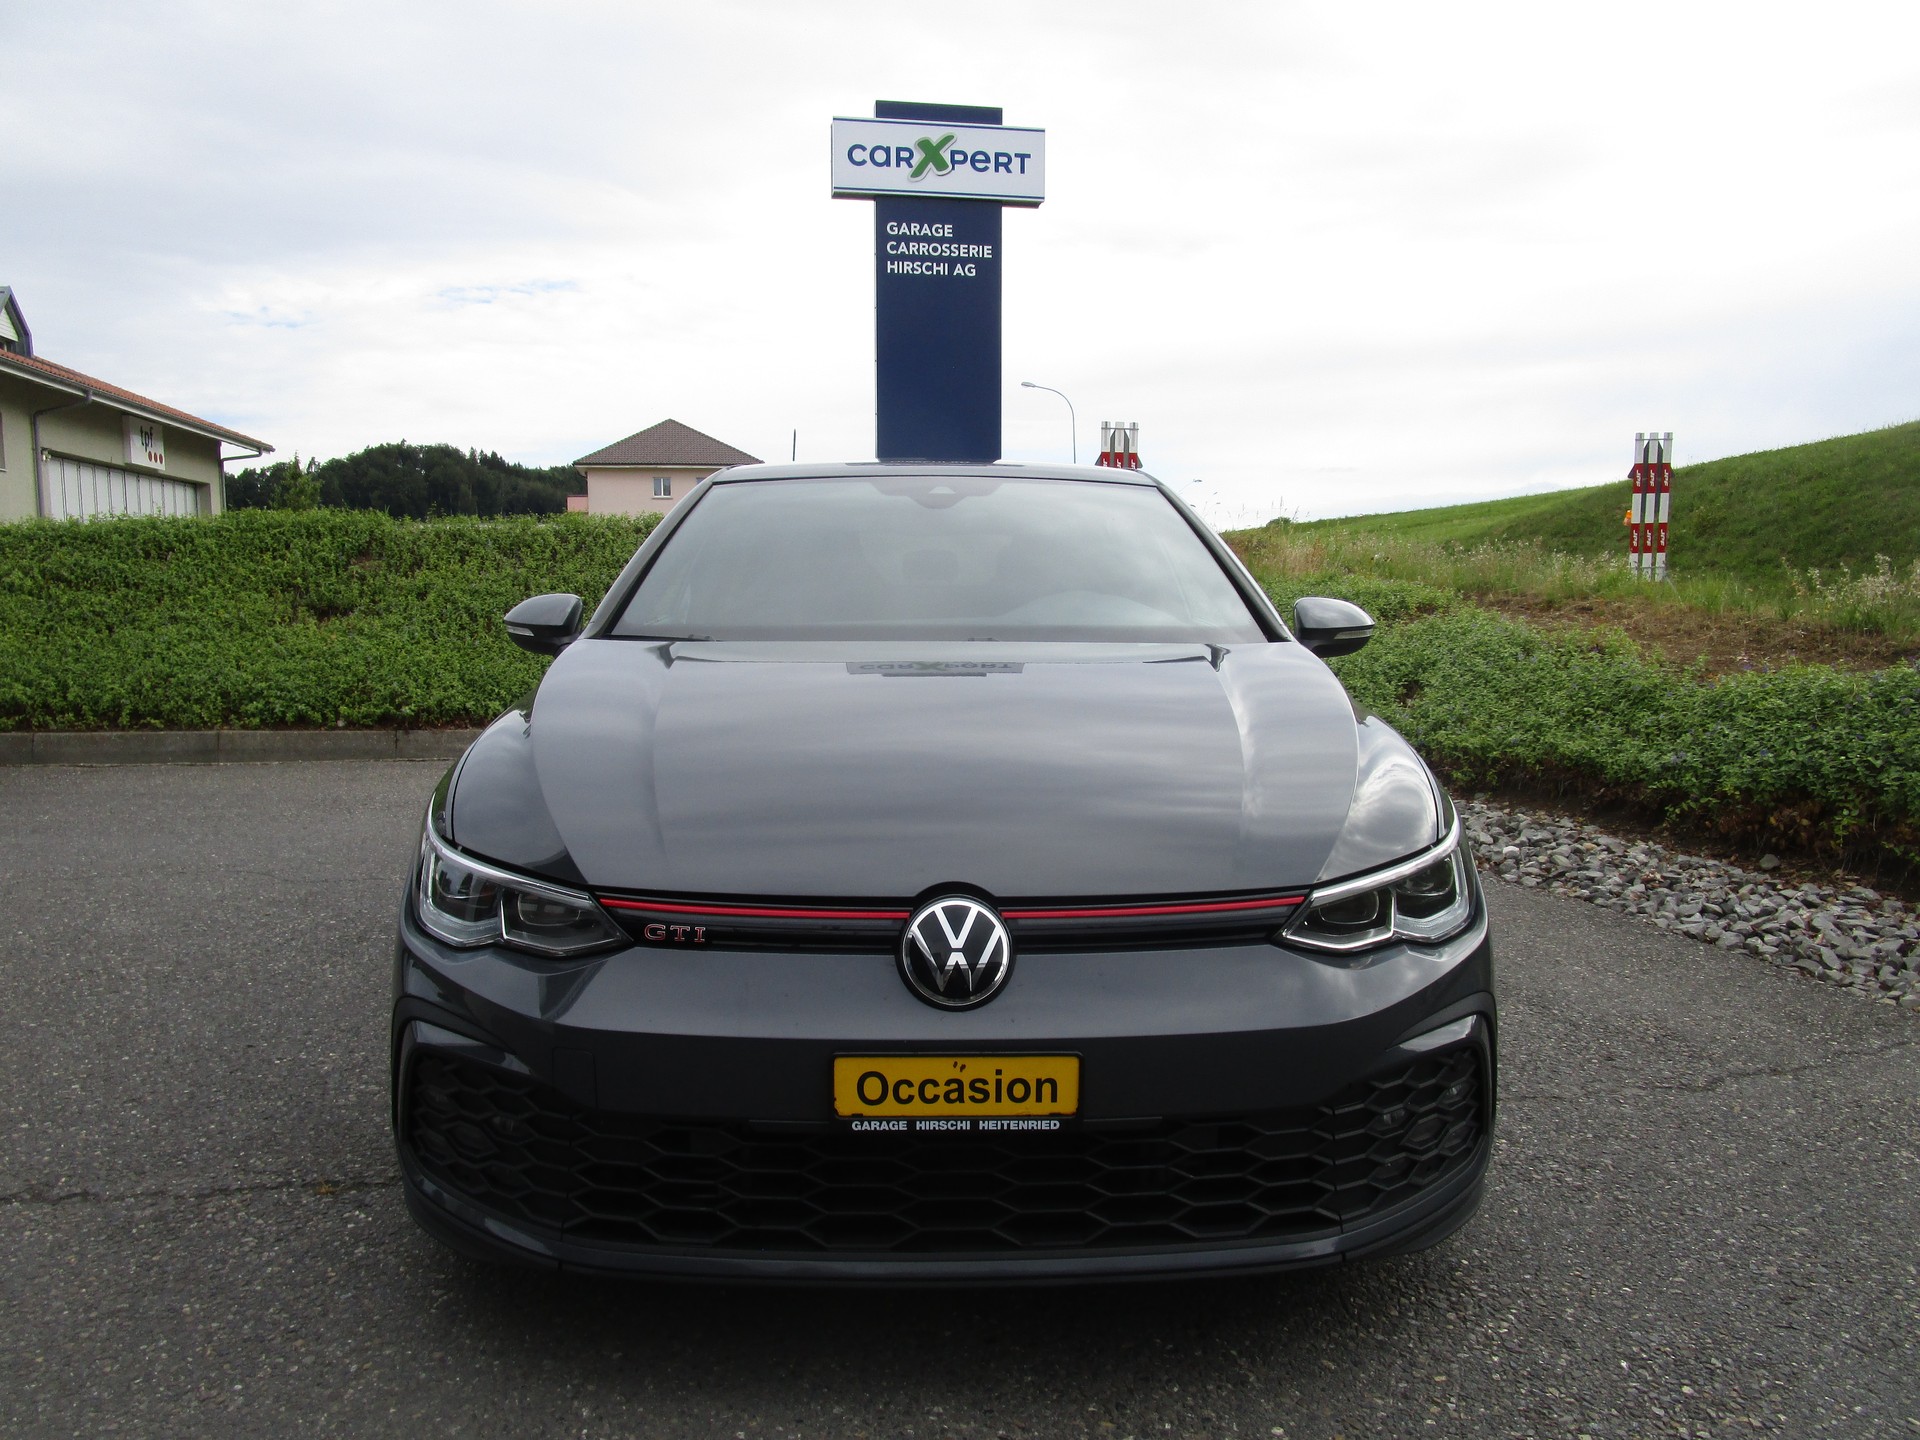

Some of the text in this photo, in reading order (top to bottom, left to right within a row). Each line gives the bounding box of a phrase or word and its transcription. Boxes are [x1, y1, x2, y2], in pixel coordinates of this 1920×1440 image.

[886, 221, 953, 237] GARAGE
[886, 241, 993, 258] CARROSSERIE
[887, 260, 976, 277] HIRSCHI AG
[140, 426, 153, 452] tpf
[643, 922, 706, 943] GTI
[856, 1069, 1058, 1106] Occasion
[851, 1120, 1061, 1132] GARAGE HIRSCHI HEITENRIED
